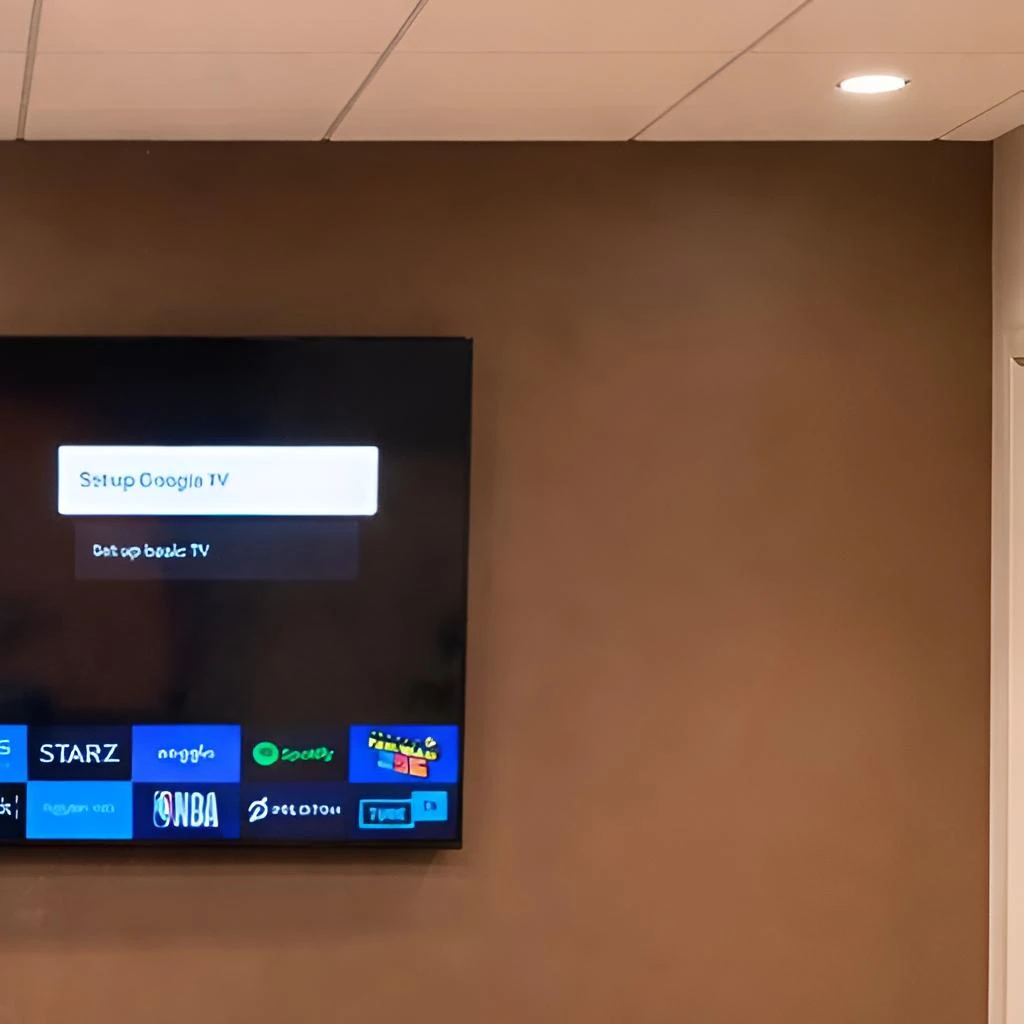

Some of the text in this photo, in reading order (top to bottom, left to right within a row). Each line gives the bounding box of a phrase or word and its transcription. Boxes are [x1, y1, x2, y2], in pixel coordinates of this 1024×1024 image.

[110, 475, 136, 493] up
[209, 473, 229, 488] TV
[190, 543, 210, 558] TV
[39, 743, 120, 763] STARZ
[172, 791, 219, 828] NBA
